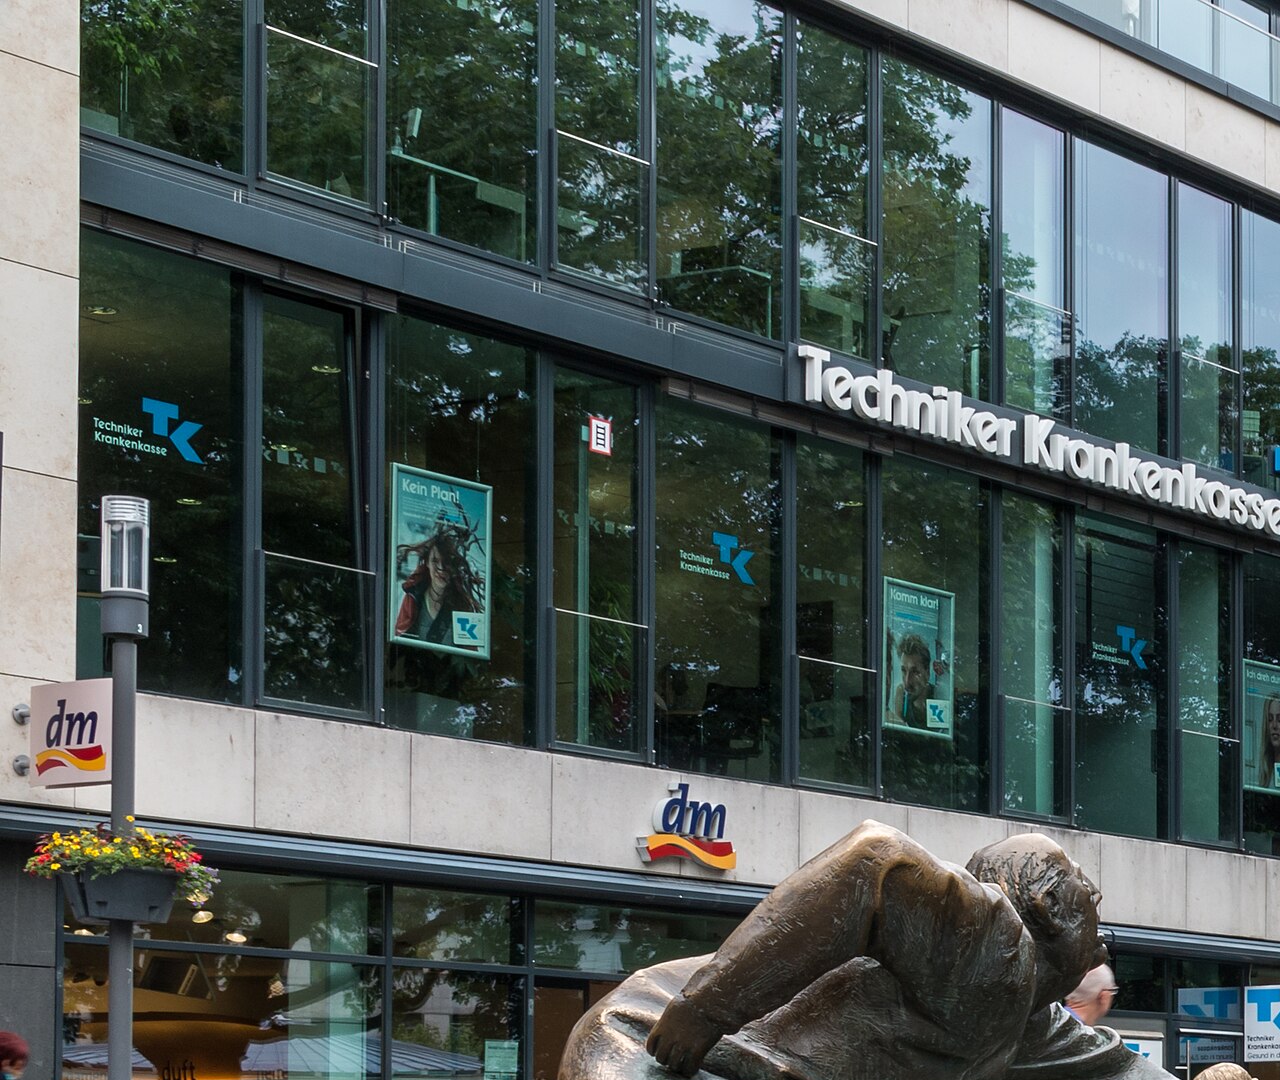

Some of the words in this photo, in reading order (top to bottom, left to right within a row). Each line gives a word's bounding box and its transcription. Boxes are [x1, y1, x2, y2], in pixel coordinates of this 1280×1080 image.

[798, 345, 1015, 456] Techniker
[93, 416, 144, 438] Techniker
[142, 396, 205, 465] TK
[94, 430, 168, 456] Krankenkasse
[402, 478, 428, 497] Kein
[431, 484, 460, 504] Plan!
[680, 549, 714, 565] Techniker
[713, 531, 756, 587] TK
[680, 561, 731, 580] Krankenkasse
[890, 588, 918, 605] Komm
[920, 594, 939, 610] klar!
[137, 623, 143, 633] 3
[456, 617, 479, 640] TK
[1116, 624, 1149, 670] TK
[46, 699, 98, 748] dm
[655, 783, 727, 839] dm
[1247, 1035, 1275, 1043] Techniker
[1247, 1052, 1269, 1060] Gesund
